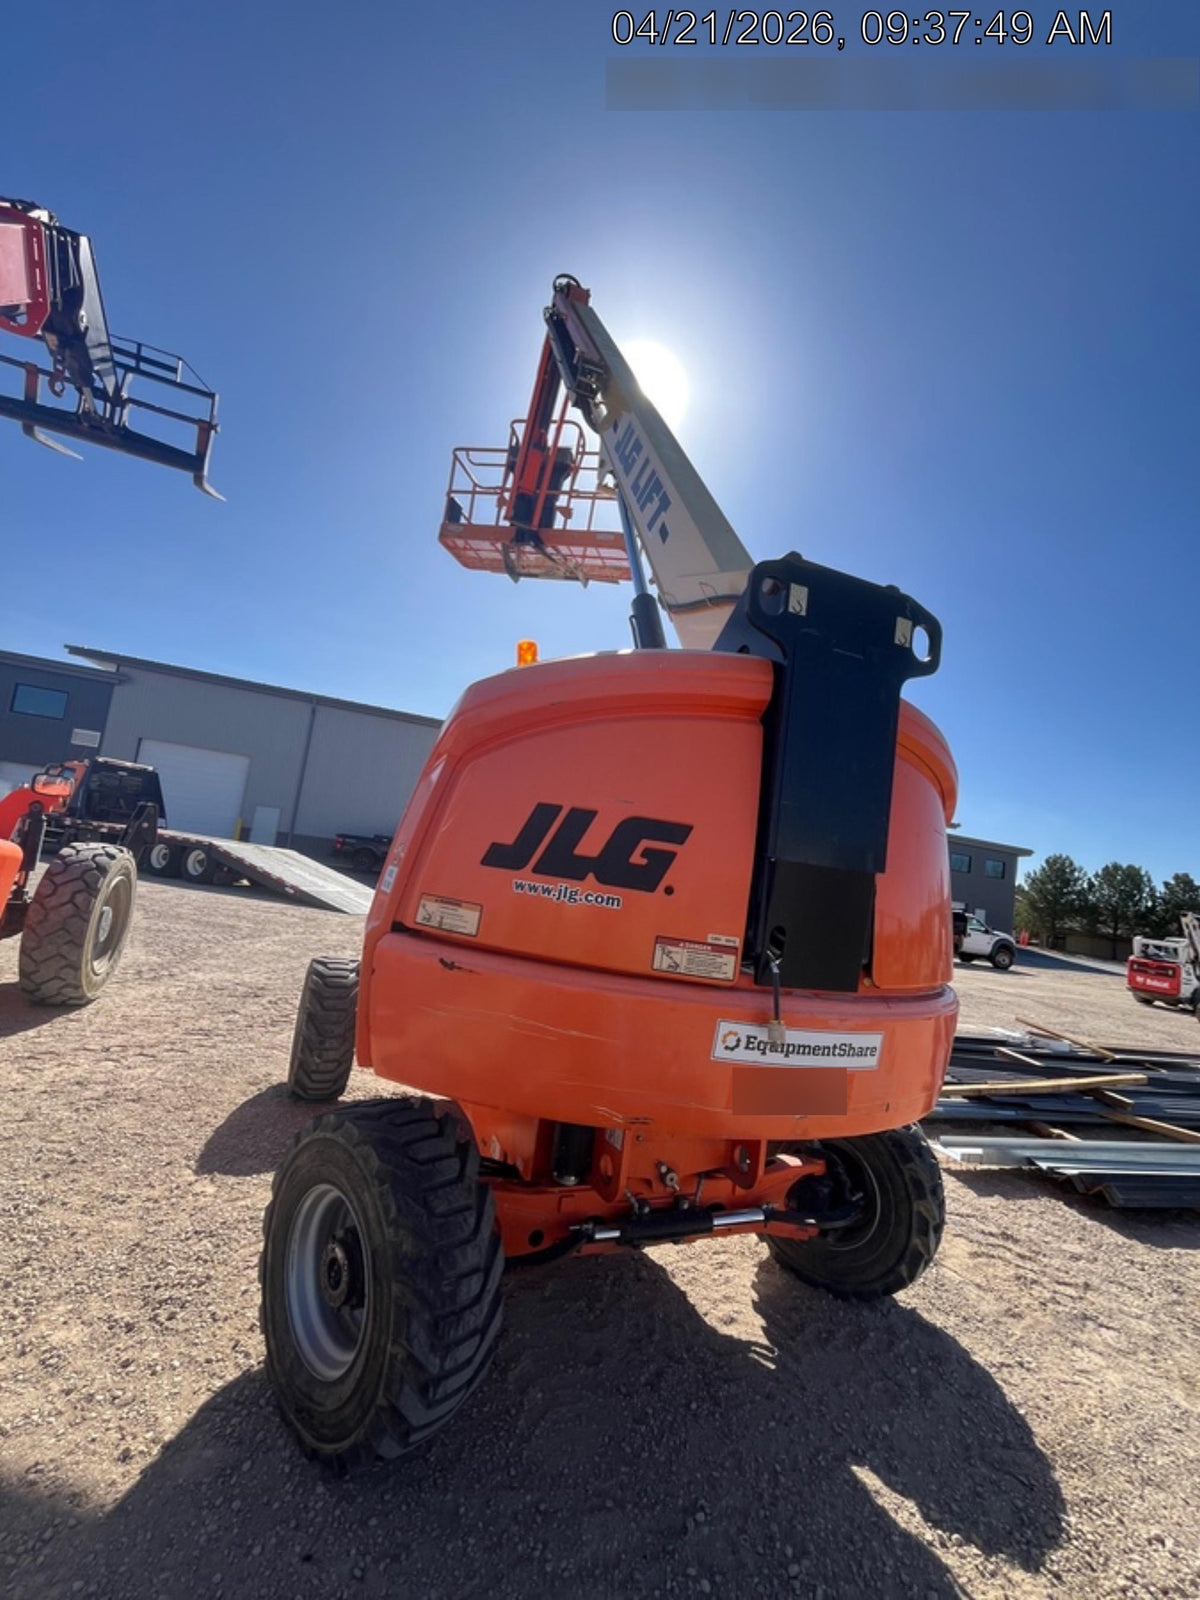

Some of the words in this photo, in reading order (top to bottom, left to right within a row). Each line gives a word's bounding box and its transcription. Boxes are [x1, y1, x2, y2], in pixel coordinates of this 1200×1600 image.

[613, 421, 644, 479] JLG
[630, 455, 673, 533] LIFT
[480, 802, 694, 893] JLG
[513, 879, 622, 909] www.jlg.com
[743, 1034, 878, 1058] EquipmentShare
